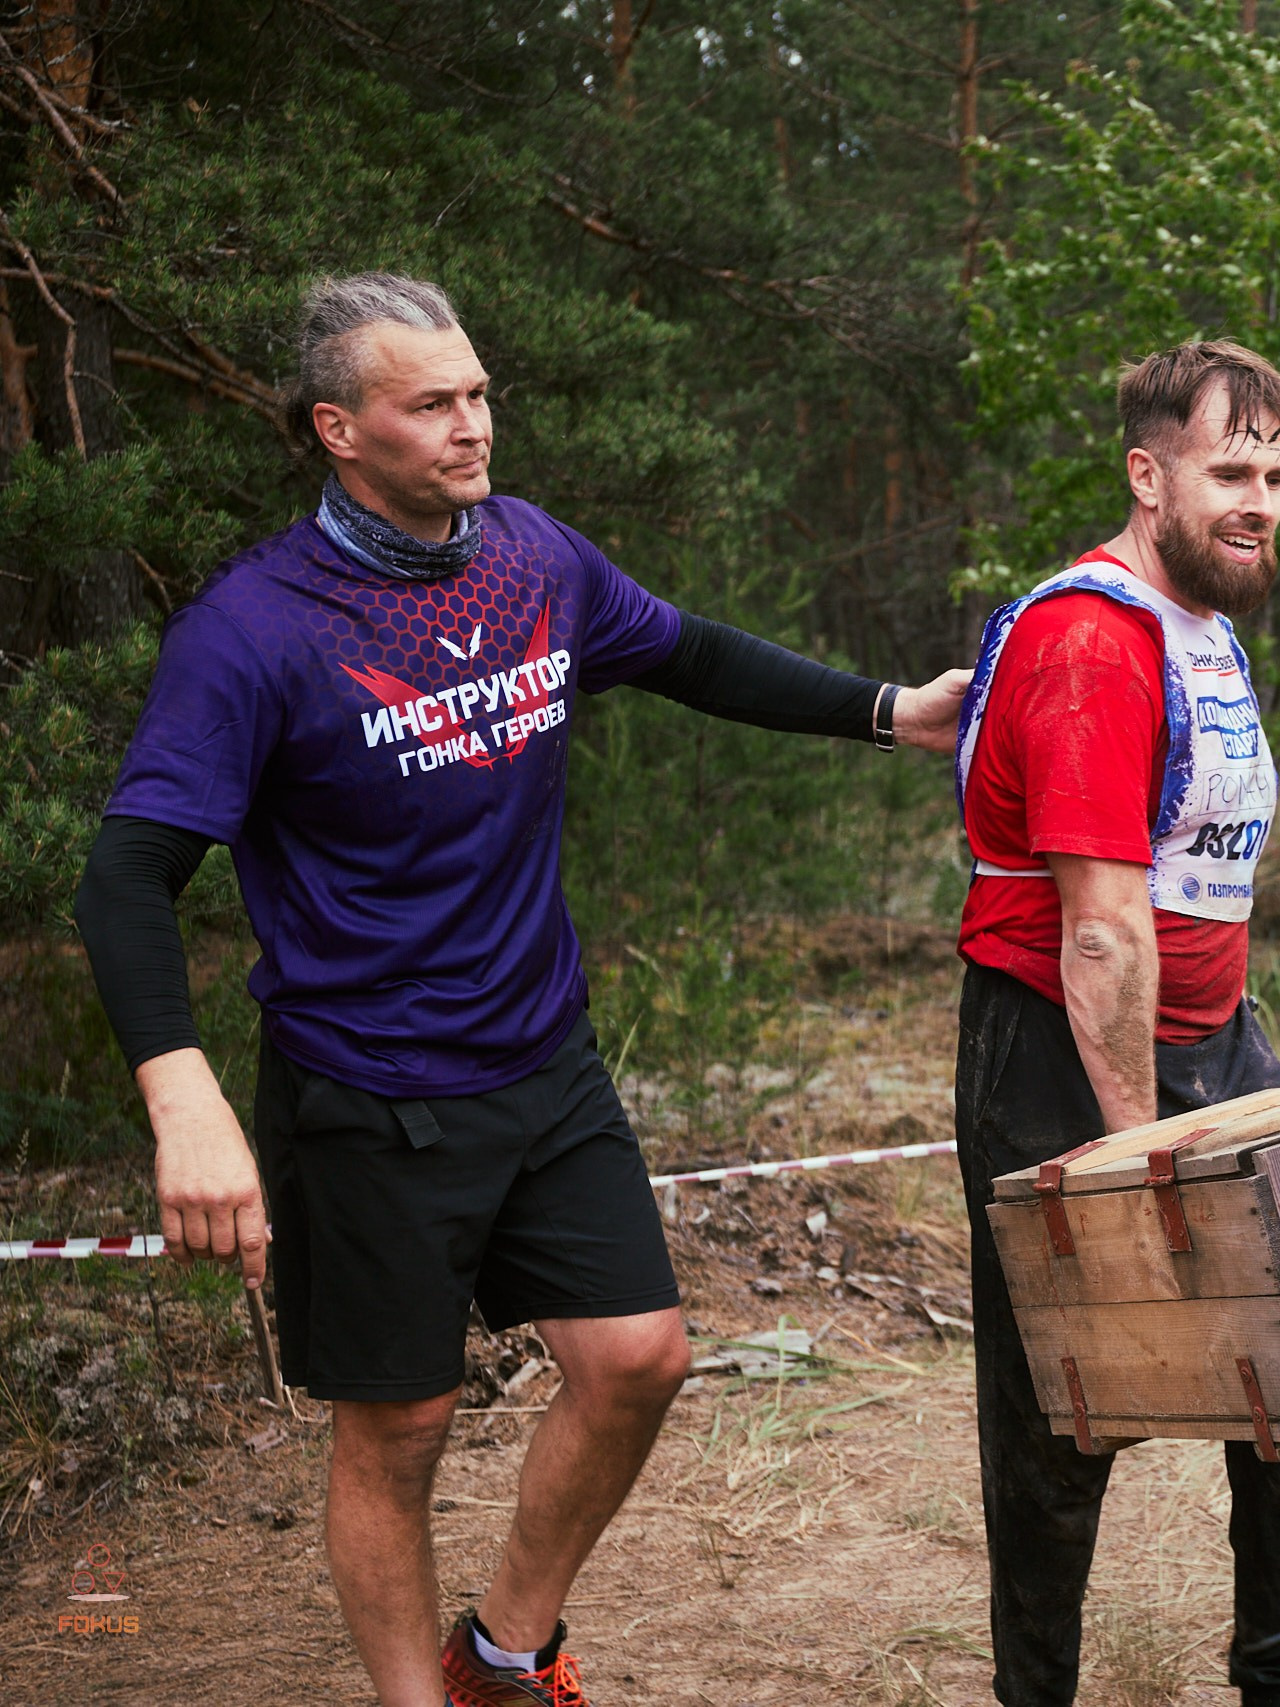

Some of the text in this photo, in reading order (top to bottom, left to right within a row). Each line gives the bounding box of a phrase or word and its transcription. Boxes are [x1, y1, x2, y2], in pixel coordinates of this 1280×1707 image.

[361, 649, 571, 747] ИНСТРУКТОР
[398, 699, 565, 777] ГОНКА ГЕРОЕВ
